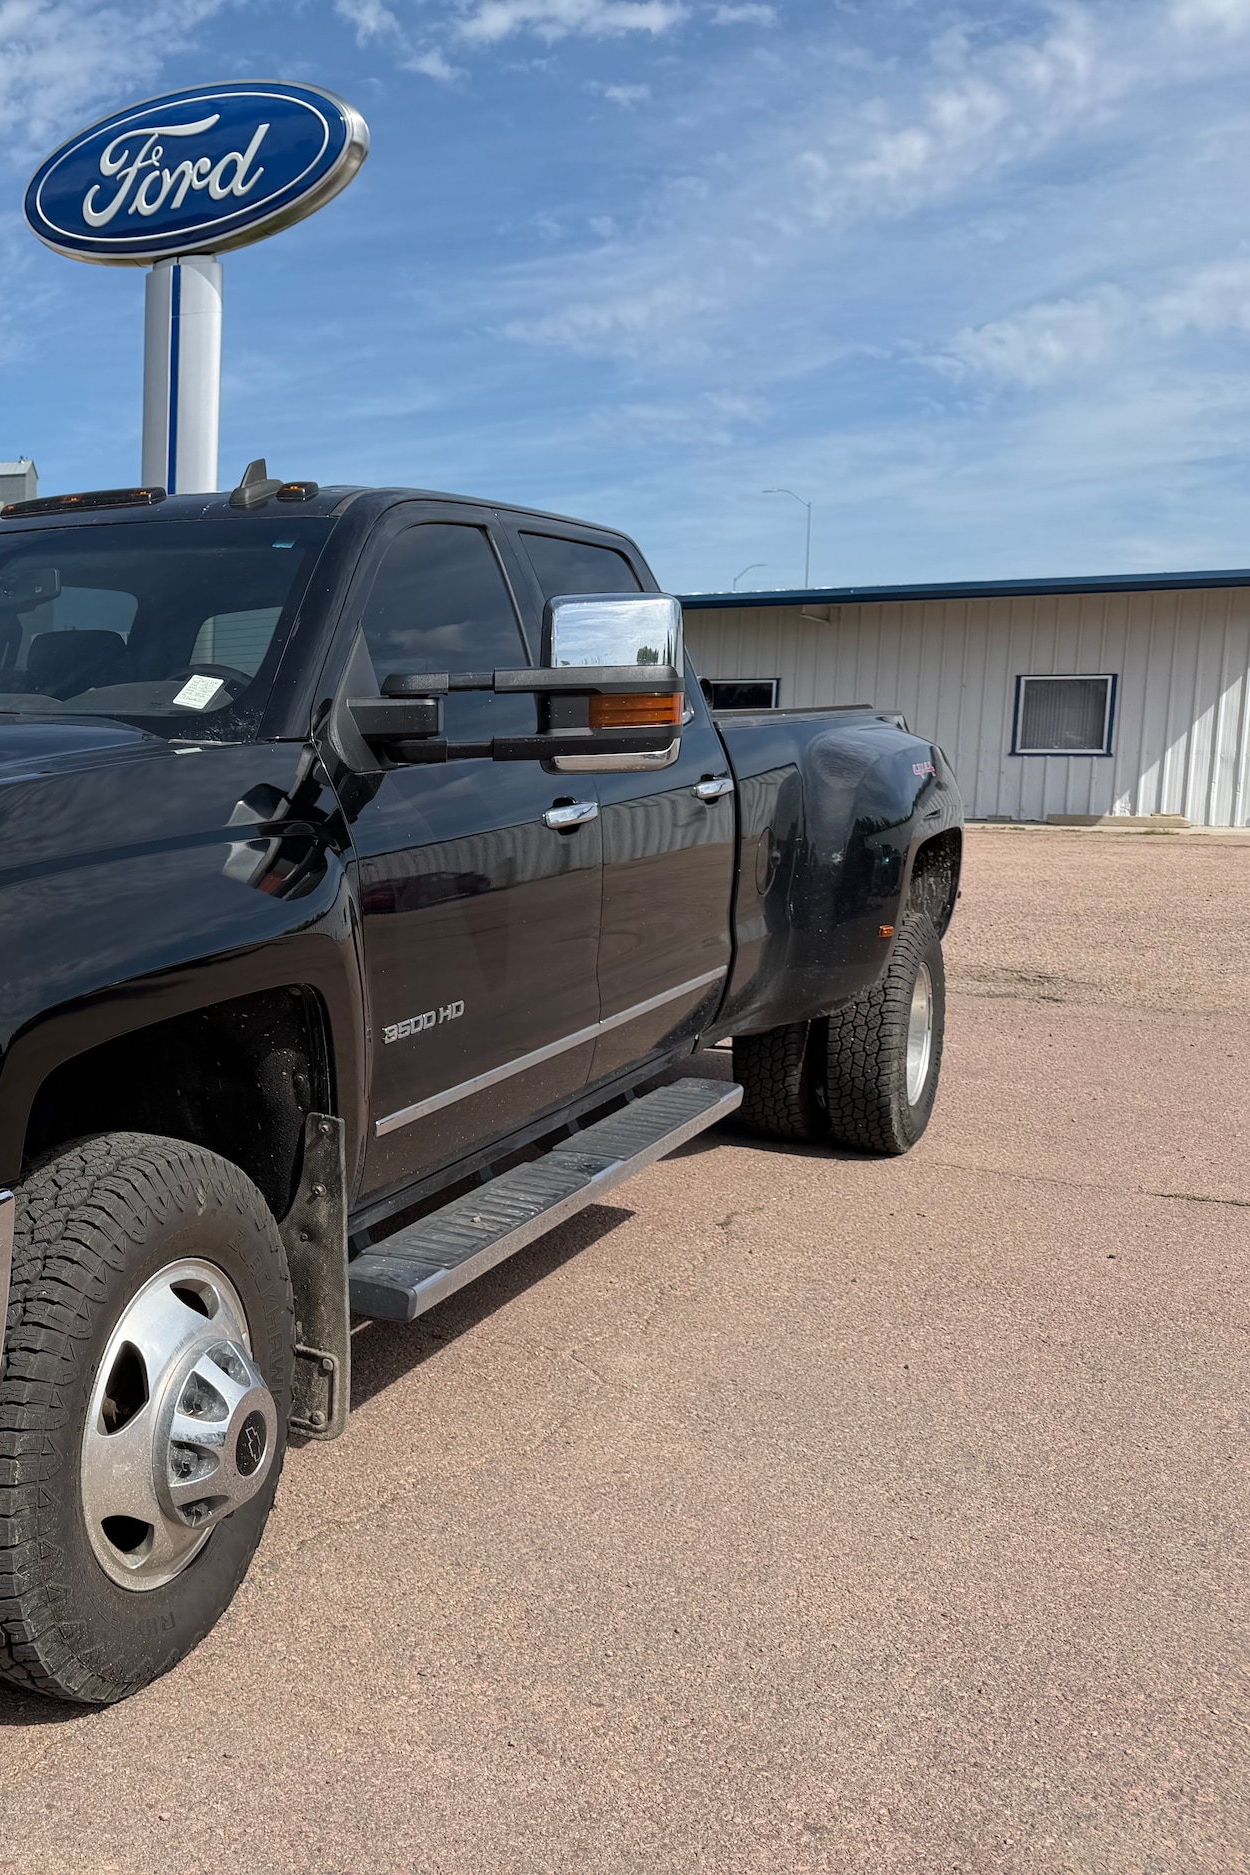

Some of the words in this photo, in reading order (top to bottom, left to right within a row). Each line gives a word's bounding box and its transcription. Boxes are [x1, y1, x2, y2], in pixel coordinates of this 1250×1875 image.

[82, 113, 270, 227] Ford
[382, 1010, 436, 1044] 3500
[439, 1000, 465, 1024] HD
